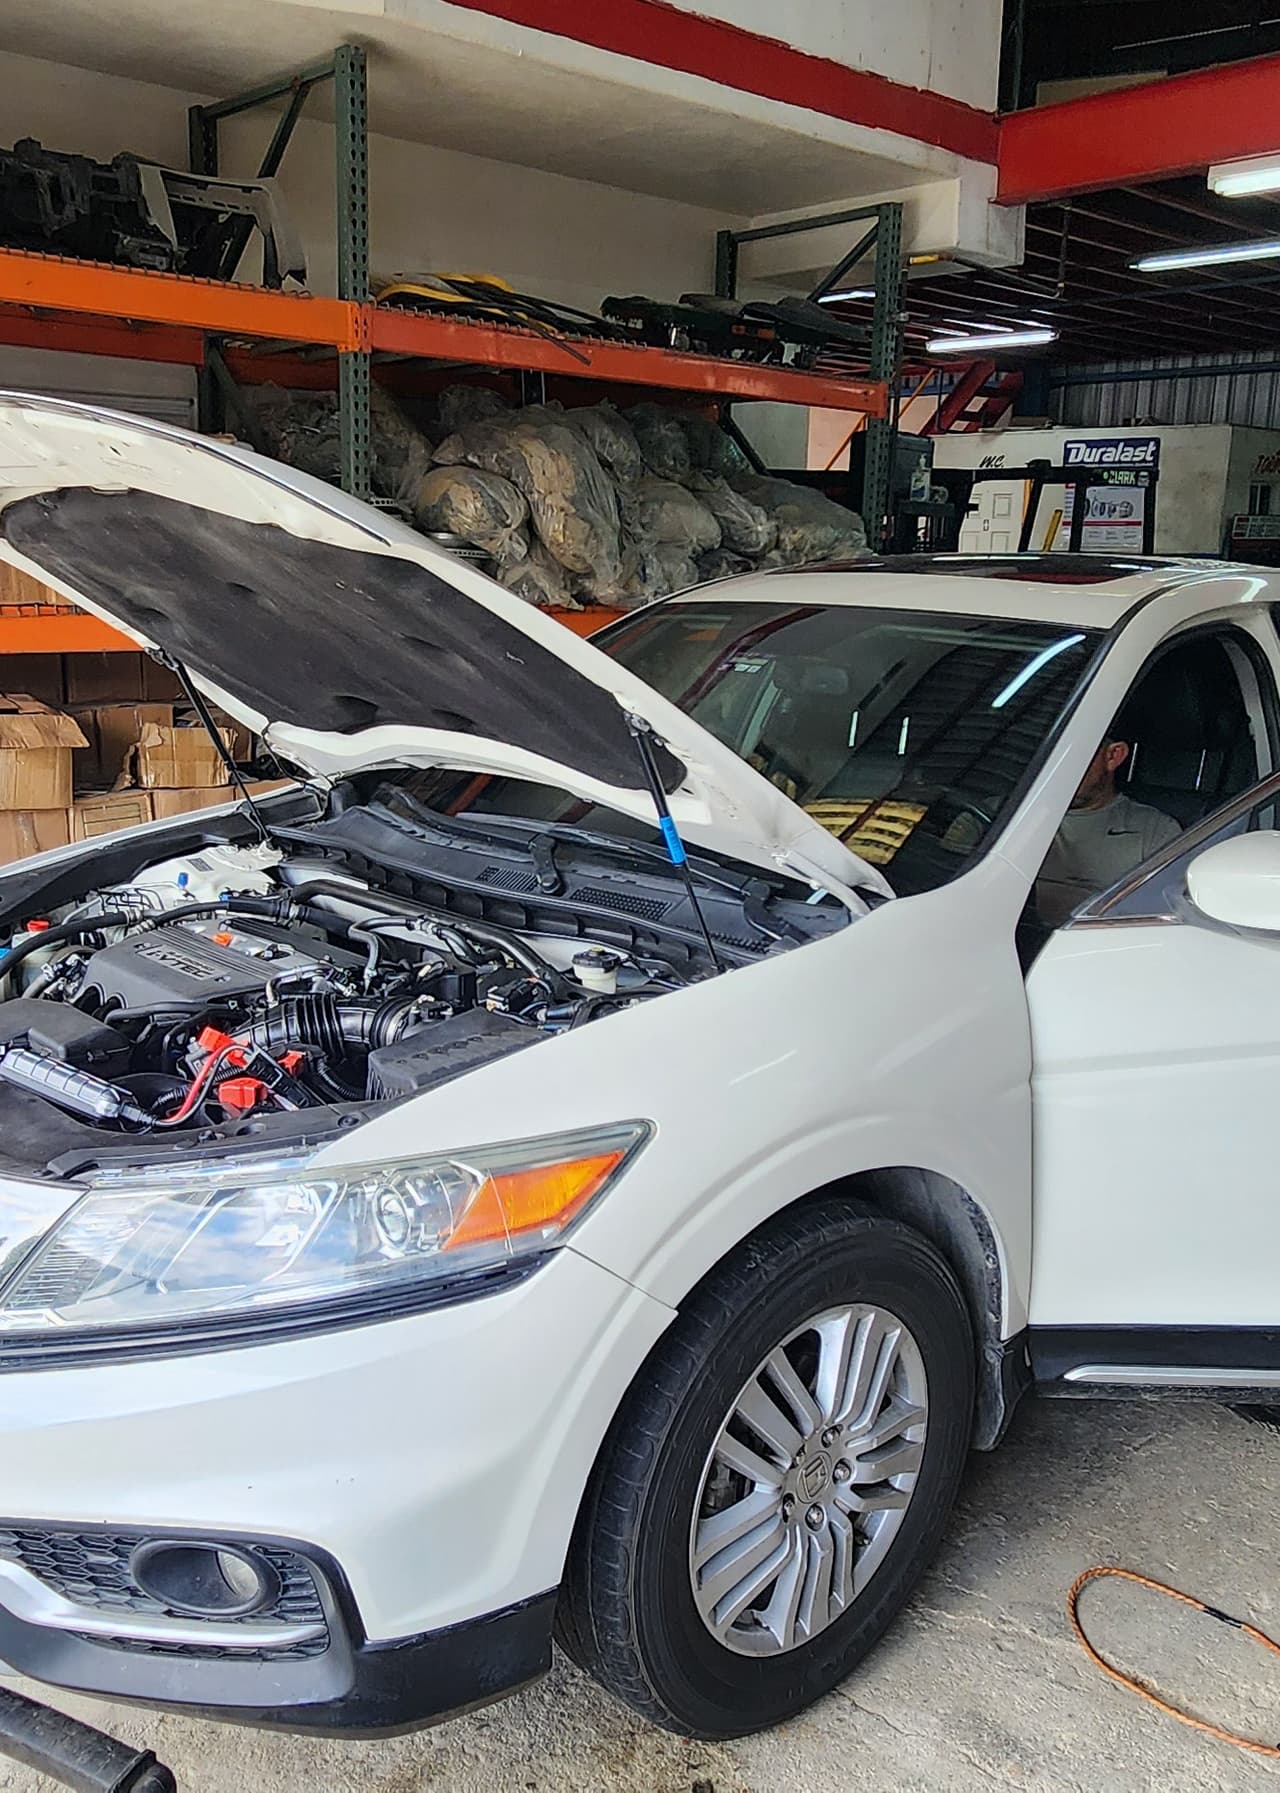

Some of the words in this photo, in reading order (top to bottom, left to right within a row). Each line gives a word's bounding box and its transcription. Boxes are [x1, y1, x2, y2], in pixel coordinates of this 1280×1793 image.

[1066, 441, 1156, 463] Duralast
[979, 455, 1005, 468] W.C.
[1109, 470, 1136, 485] CLARK
